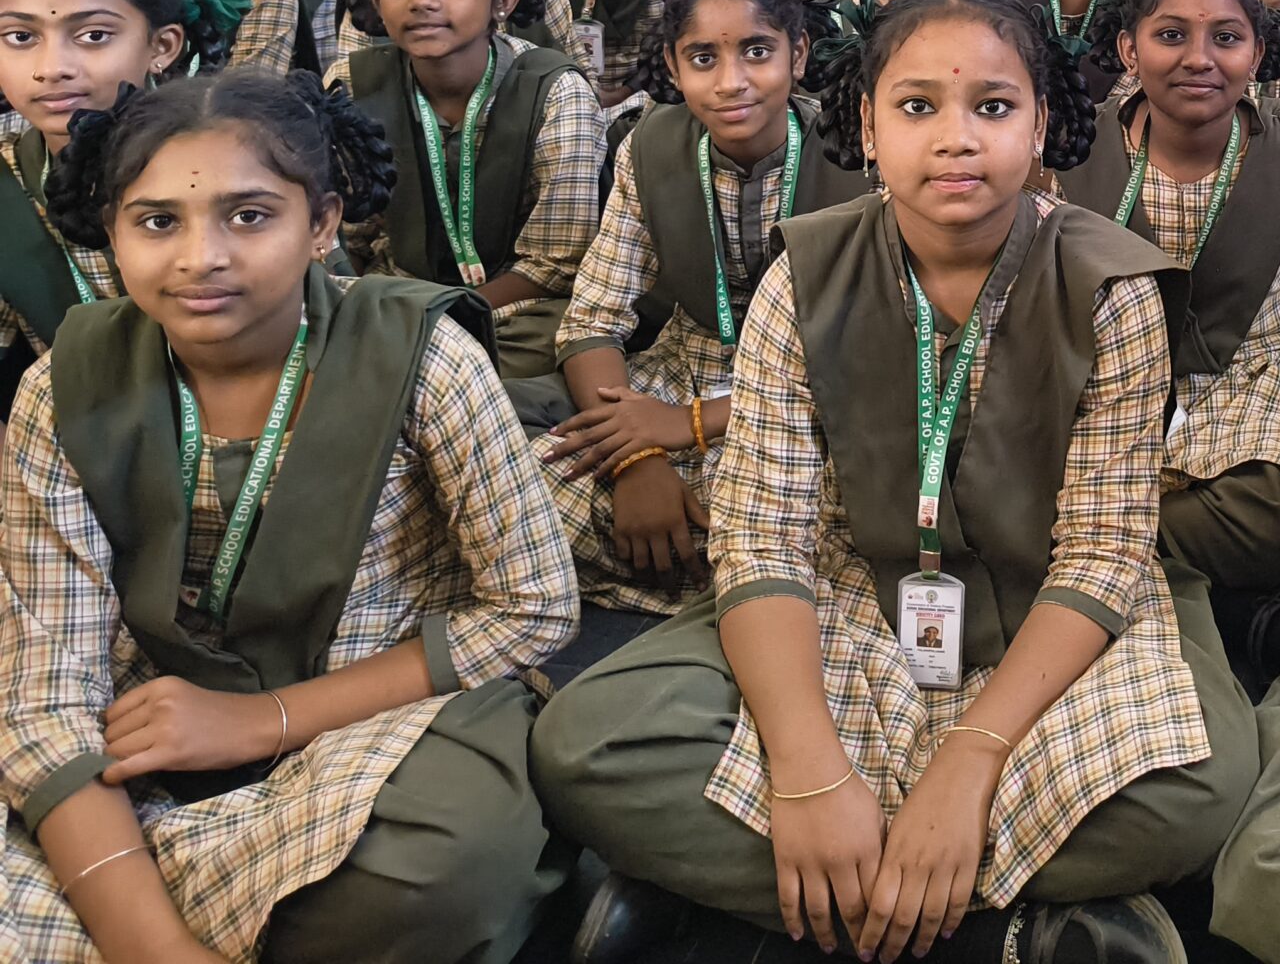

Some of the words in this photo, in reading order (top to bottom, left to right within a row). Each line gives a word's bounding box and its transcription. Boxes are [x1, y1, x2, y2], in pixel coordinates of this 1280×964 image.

[421, 106, 440, 163] EDUCATIONAL
[463, 110, 475, 166] EDUCATIONAL
[784, 120, 798, 182] DEPARTMENT
[462, 168, 471, 202] SCHOOL
[1115, 159, 1144, 221] EDUCATIONAL
[1199, 184, 1224, 247] EDUCATIONAL
[1218, 121, 1239, 183] DEPARTMENT
[462, 203, 470, 219] A.P.
[462, 221, 470, 232] OF
[718, 296, 727, 308] OF
[719, 309, 732, 338] GOVT.
[268, 340, 306, 429] DEPARTMENT
[921, 343, 932, 393] SCHOOL
[945, 357, 969, 402] SCHOOL
[922, 396, 932, 419] A.P.
[939, 405, 954, 428] A.P.
[922, 421, 933, 438] OF
[934, 429, 946, 446] OF
[181, 434, 197, 488] SCHOOL
[235, 432, 277, 523] EDUCATIONAL
[927, 449, 943, 484] GOVT.
[217, 525, 244, 576] SCHOOL
[209, 597, 219, 613] OF
[213, 577, 226, 599] A.P.
